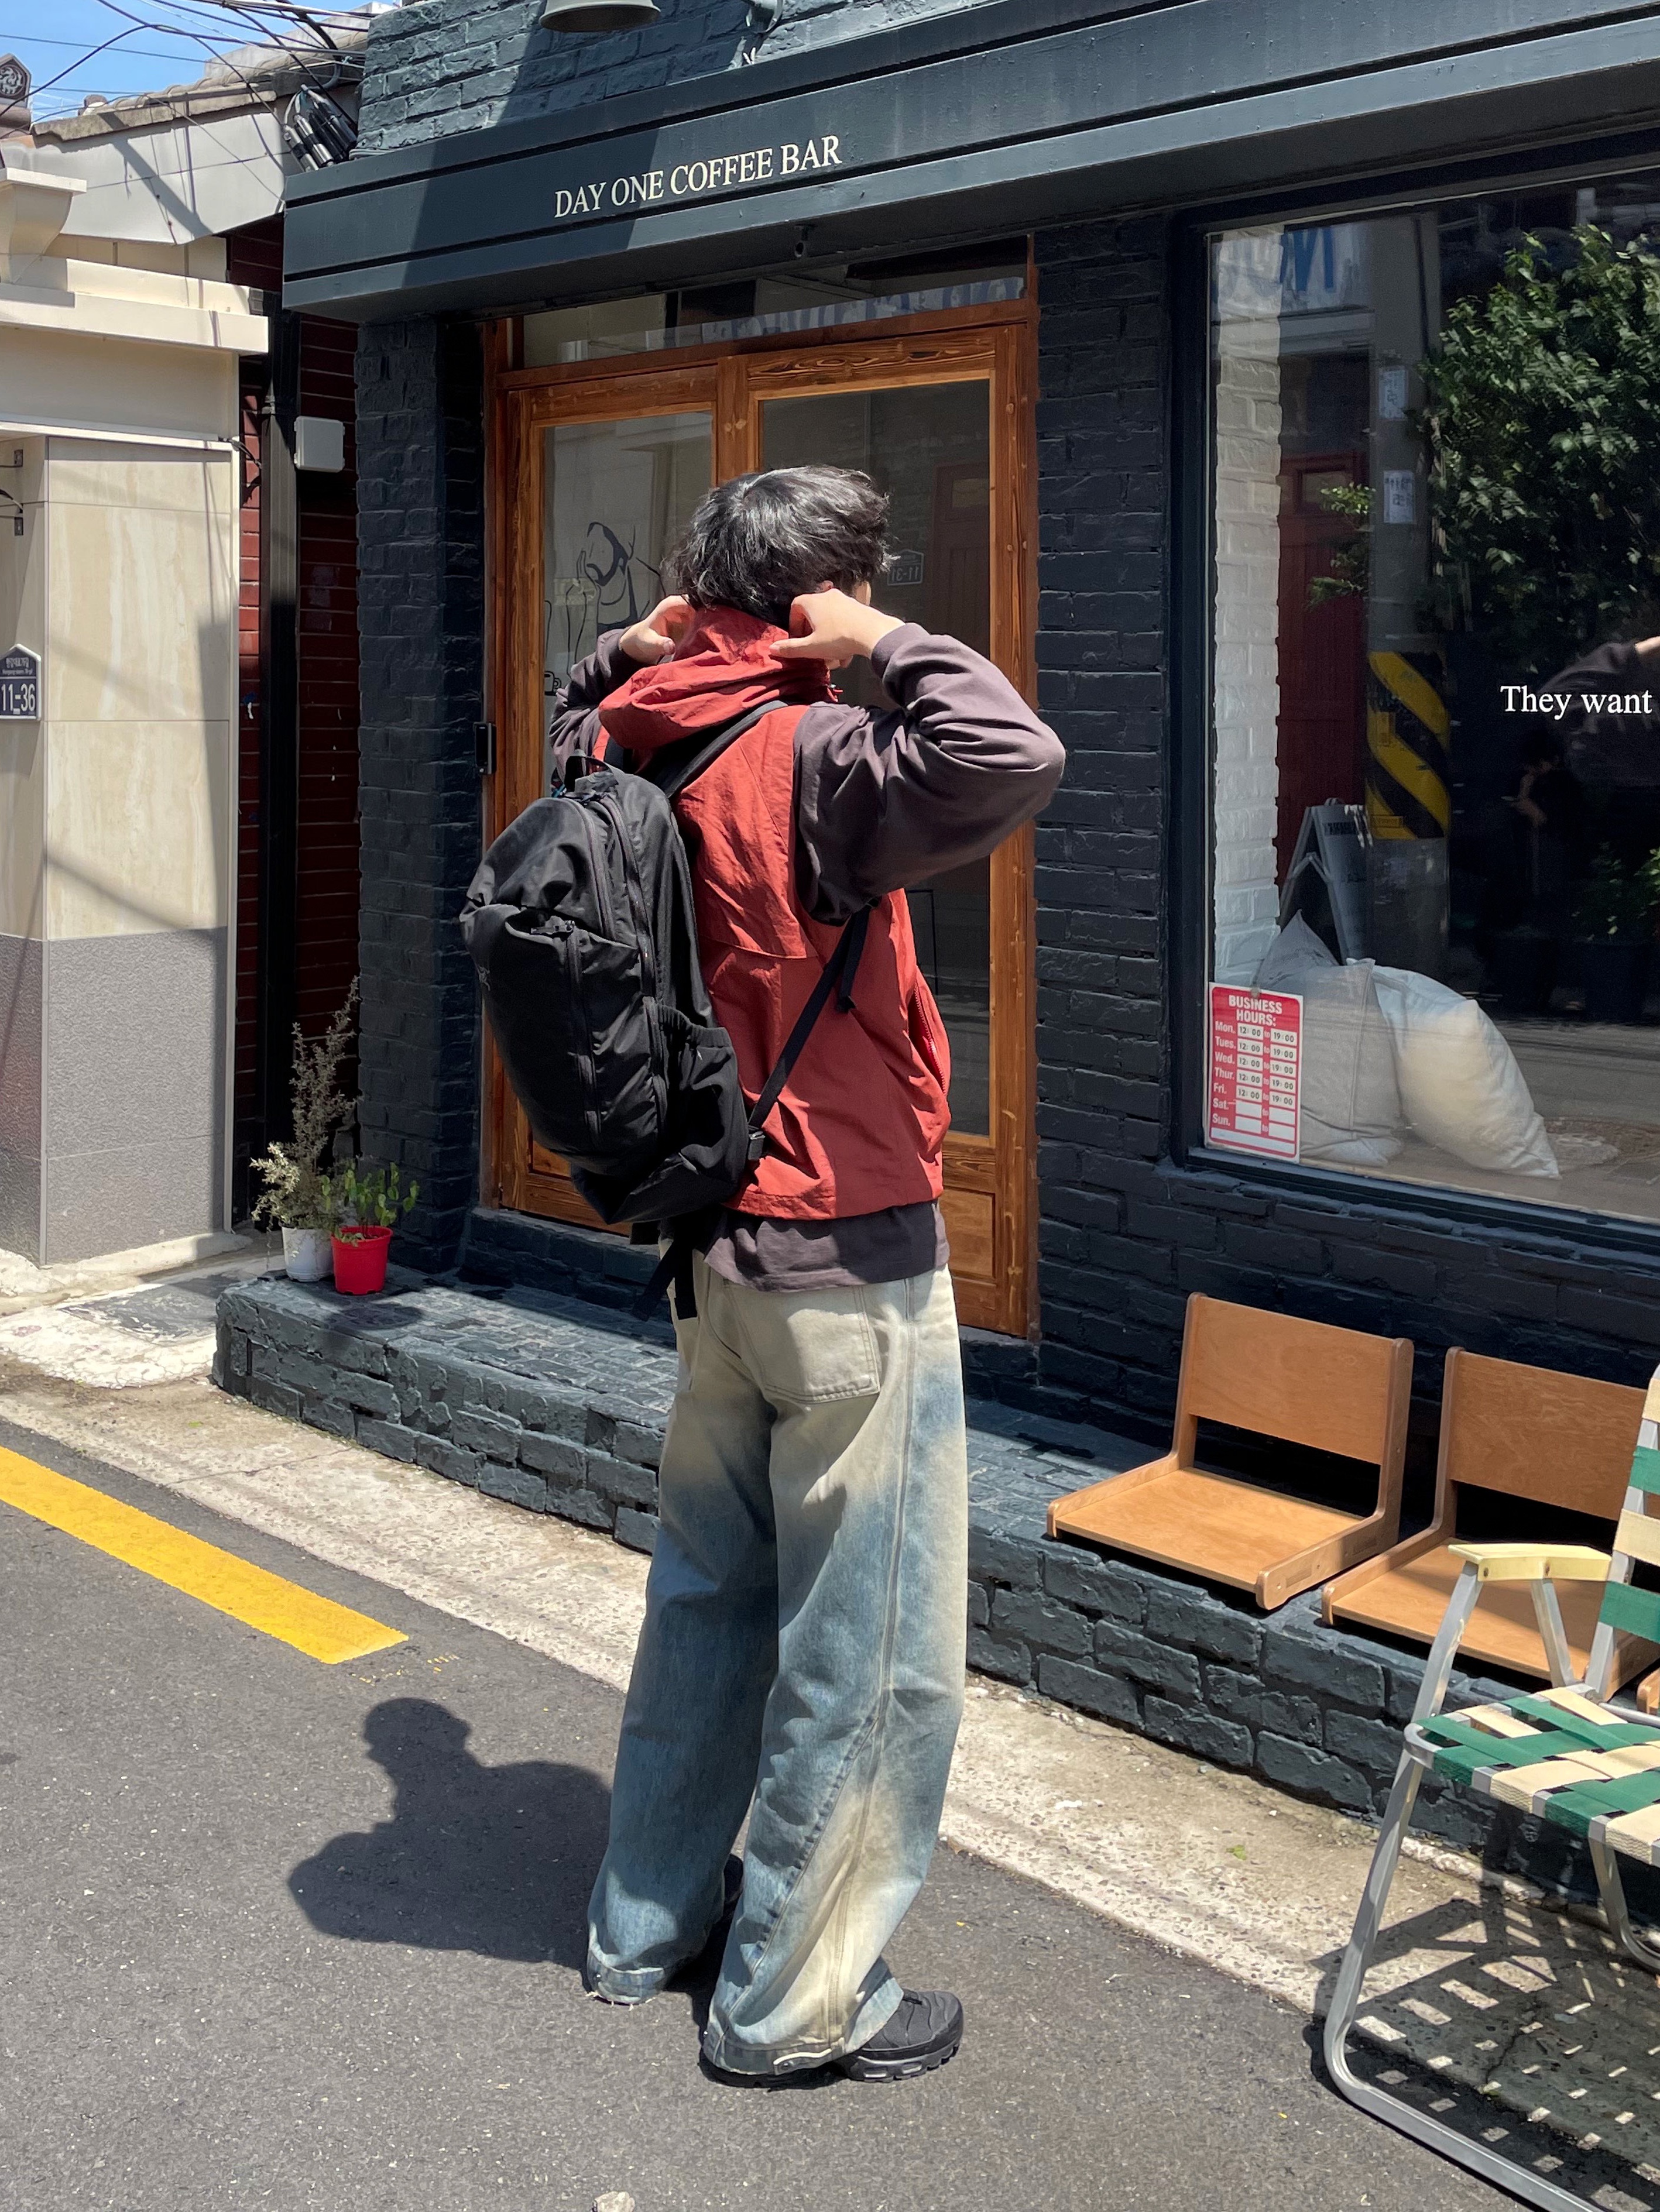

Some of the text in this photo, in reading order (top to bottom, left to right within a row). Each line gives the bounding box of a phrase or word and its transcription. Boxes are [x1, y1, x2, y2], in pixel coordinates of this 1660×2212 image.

[554, 135, 843, 218] DAY ONE COFFEE BAR
[1, 683, 35, 712] 11-36
[1500, 685, 1652, 720] They want
[1229, 995, 1282, 1014] BUSINESS
[1236, 1009, 1276, 1026] HOURS:
[1215, 1021, 1236, 1034] Mon.
[1215, 1036, 1236, 1049] Tues.
[1215, 1052, 1236, 1064] Wed.
[1214, 1067, 1234, 1080] Thur.
[1213, 1083, 1227, 1094] Fri.
[1213, 1098, 1229, 1110] Sat.
[1212, 1113, 1230, 1126] Sun.
